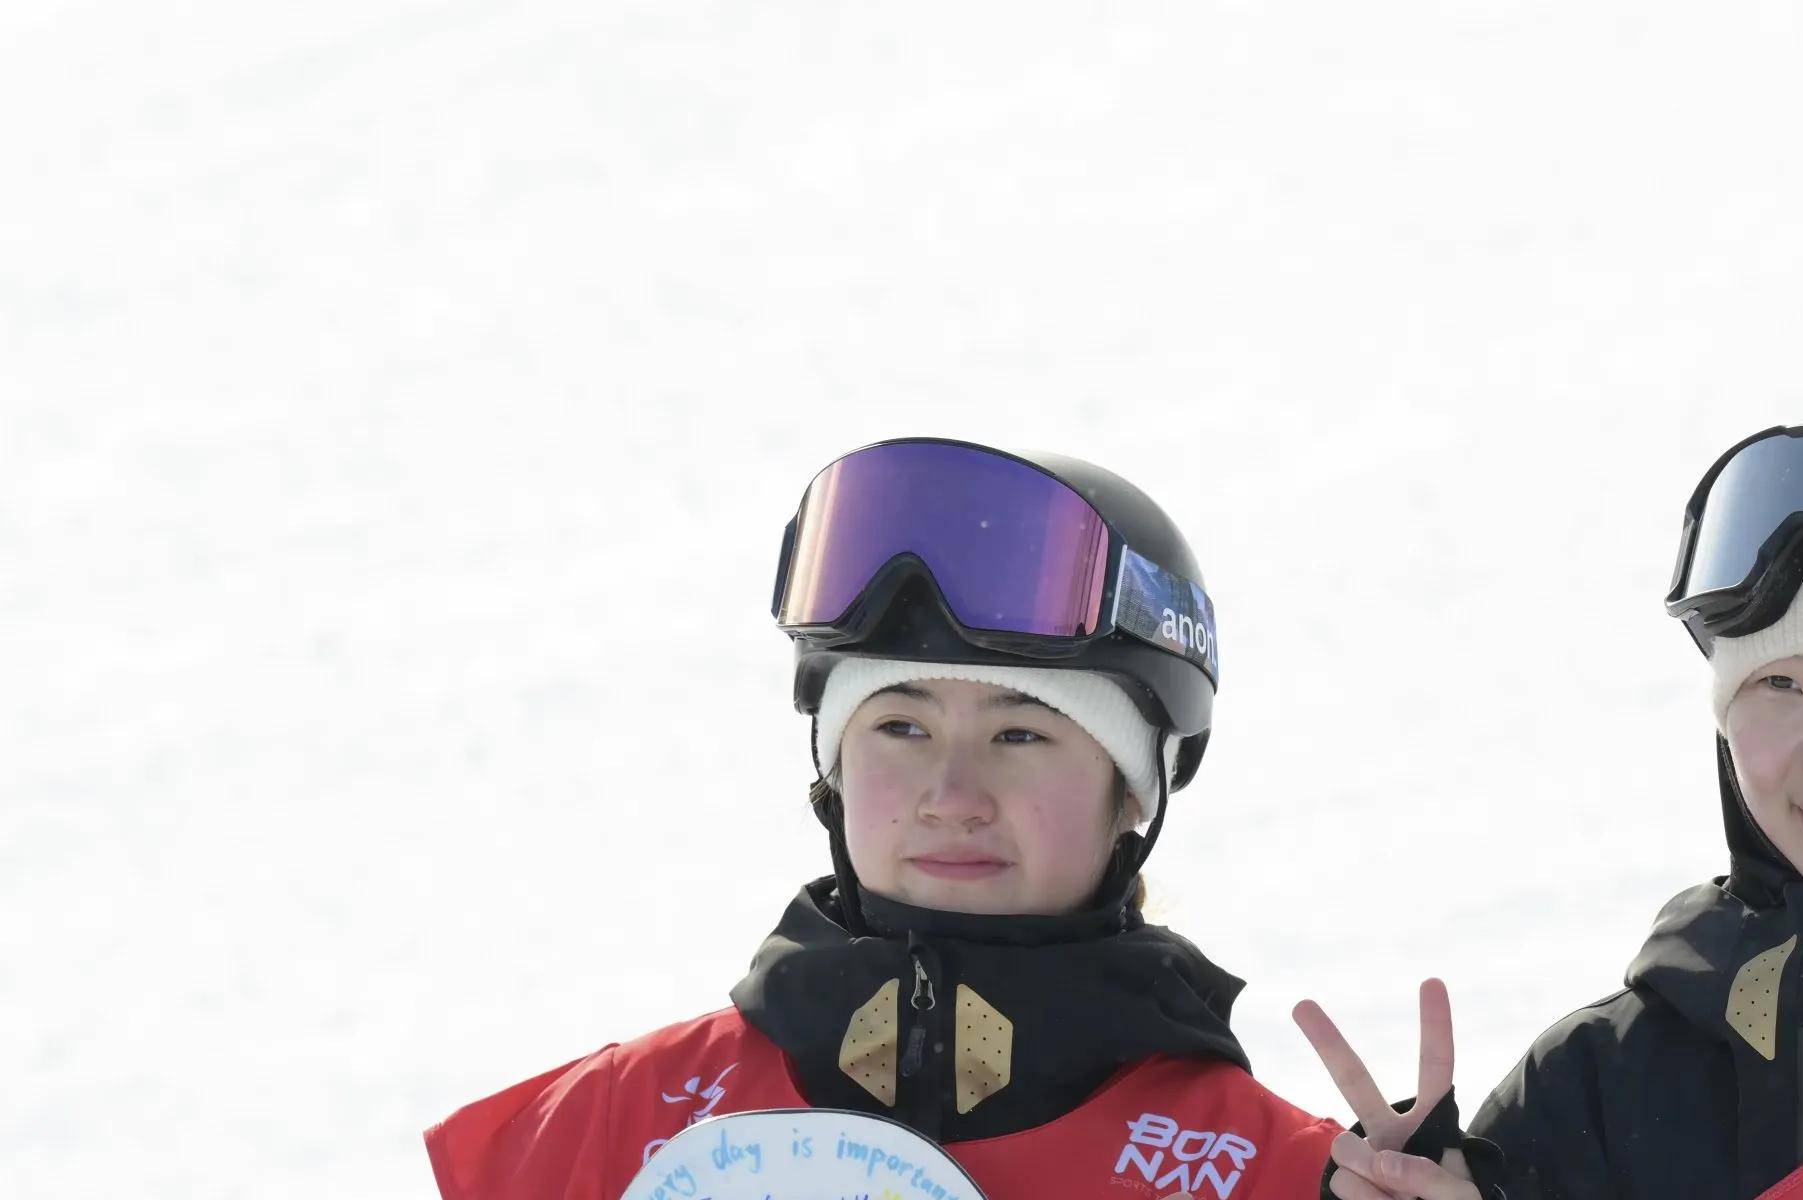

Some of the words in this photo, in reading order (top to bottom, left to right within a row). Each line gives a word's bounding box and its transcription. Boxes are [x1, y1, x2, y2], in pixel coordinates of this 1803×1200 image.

[1161, 607, 1216, 666] anon
[711, 1128, 762, 1174] day
[792, 1127, 814, 1159] is
[1126, 1112, 1258, 1171] BOR
[1114, 1143, 1242, 1200] NAN
